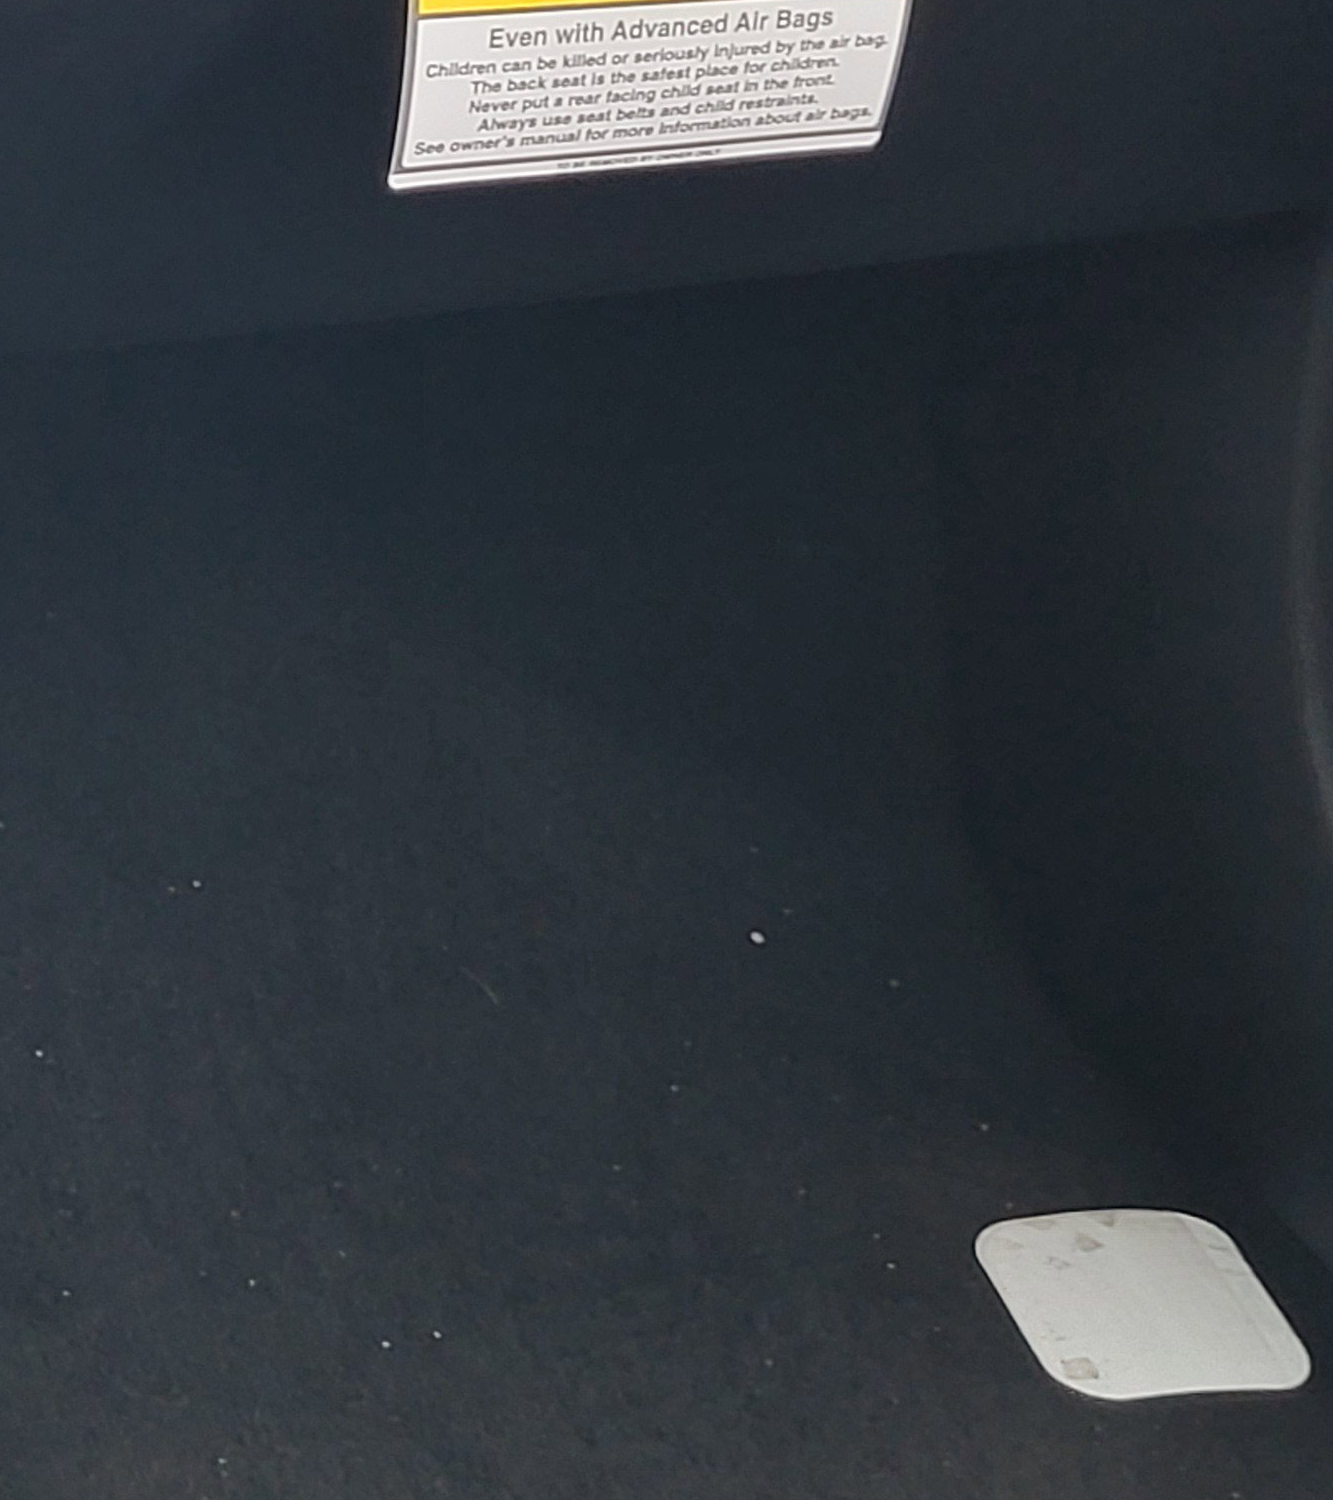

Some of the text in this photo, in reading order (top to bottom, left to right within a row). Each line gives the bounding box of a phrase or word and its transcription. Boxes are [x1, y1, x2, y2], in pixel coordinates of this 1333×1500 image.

[488, 10, 833, 49] Even with Advanced Air Bags
[425, 59, 497, 79] Children
[501, 60, 531, 74] can
[536, 55, 557, 71] be
[562, 52, 607, 69] killed
[611, 52, 630, 65] or
[634, 45, 708, 65] seriously
[714, 40, 772, 61] injured
[775, 38, 794, 57] by
[800, 35, 825, 51] the
[829, 34, 850, 49] air
[471, 55, 840, 95] The back seat is the safest place for children.
[469, 99, 517, 114] Never
[521, 96, 549, 114] put
[552, 96, 563, 108] a
[567, 94, 601, 107] rear
[605, 87, 657, 106] facing
[660, 83, 701, 100] child
[705, 80, 740, 97] seat
[743, 78, 759, 93] in
[763, 75, 789, 91] the
[413, 141, 446, 156] See
[449, 134, 515, 153] owner's
[519, 129, 581, 147] manual
[585, 126, 607, 141] for
[612, 125, 655, 140] more
[658, 115, 751, 135] information
[754, 111, 802, 128] about
[805, 108, 827, 123] air
[476, 117, 537, 133] Always
[541, 114, 572, 127] use
[576, 109, 612, 124] seat
[615, 105, 656, 122] belts
[659, 103, 691, 117] and
[694, 99, 735, 115] child
